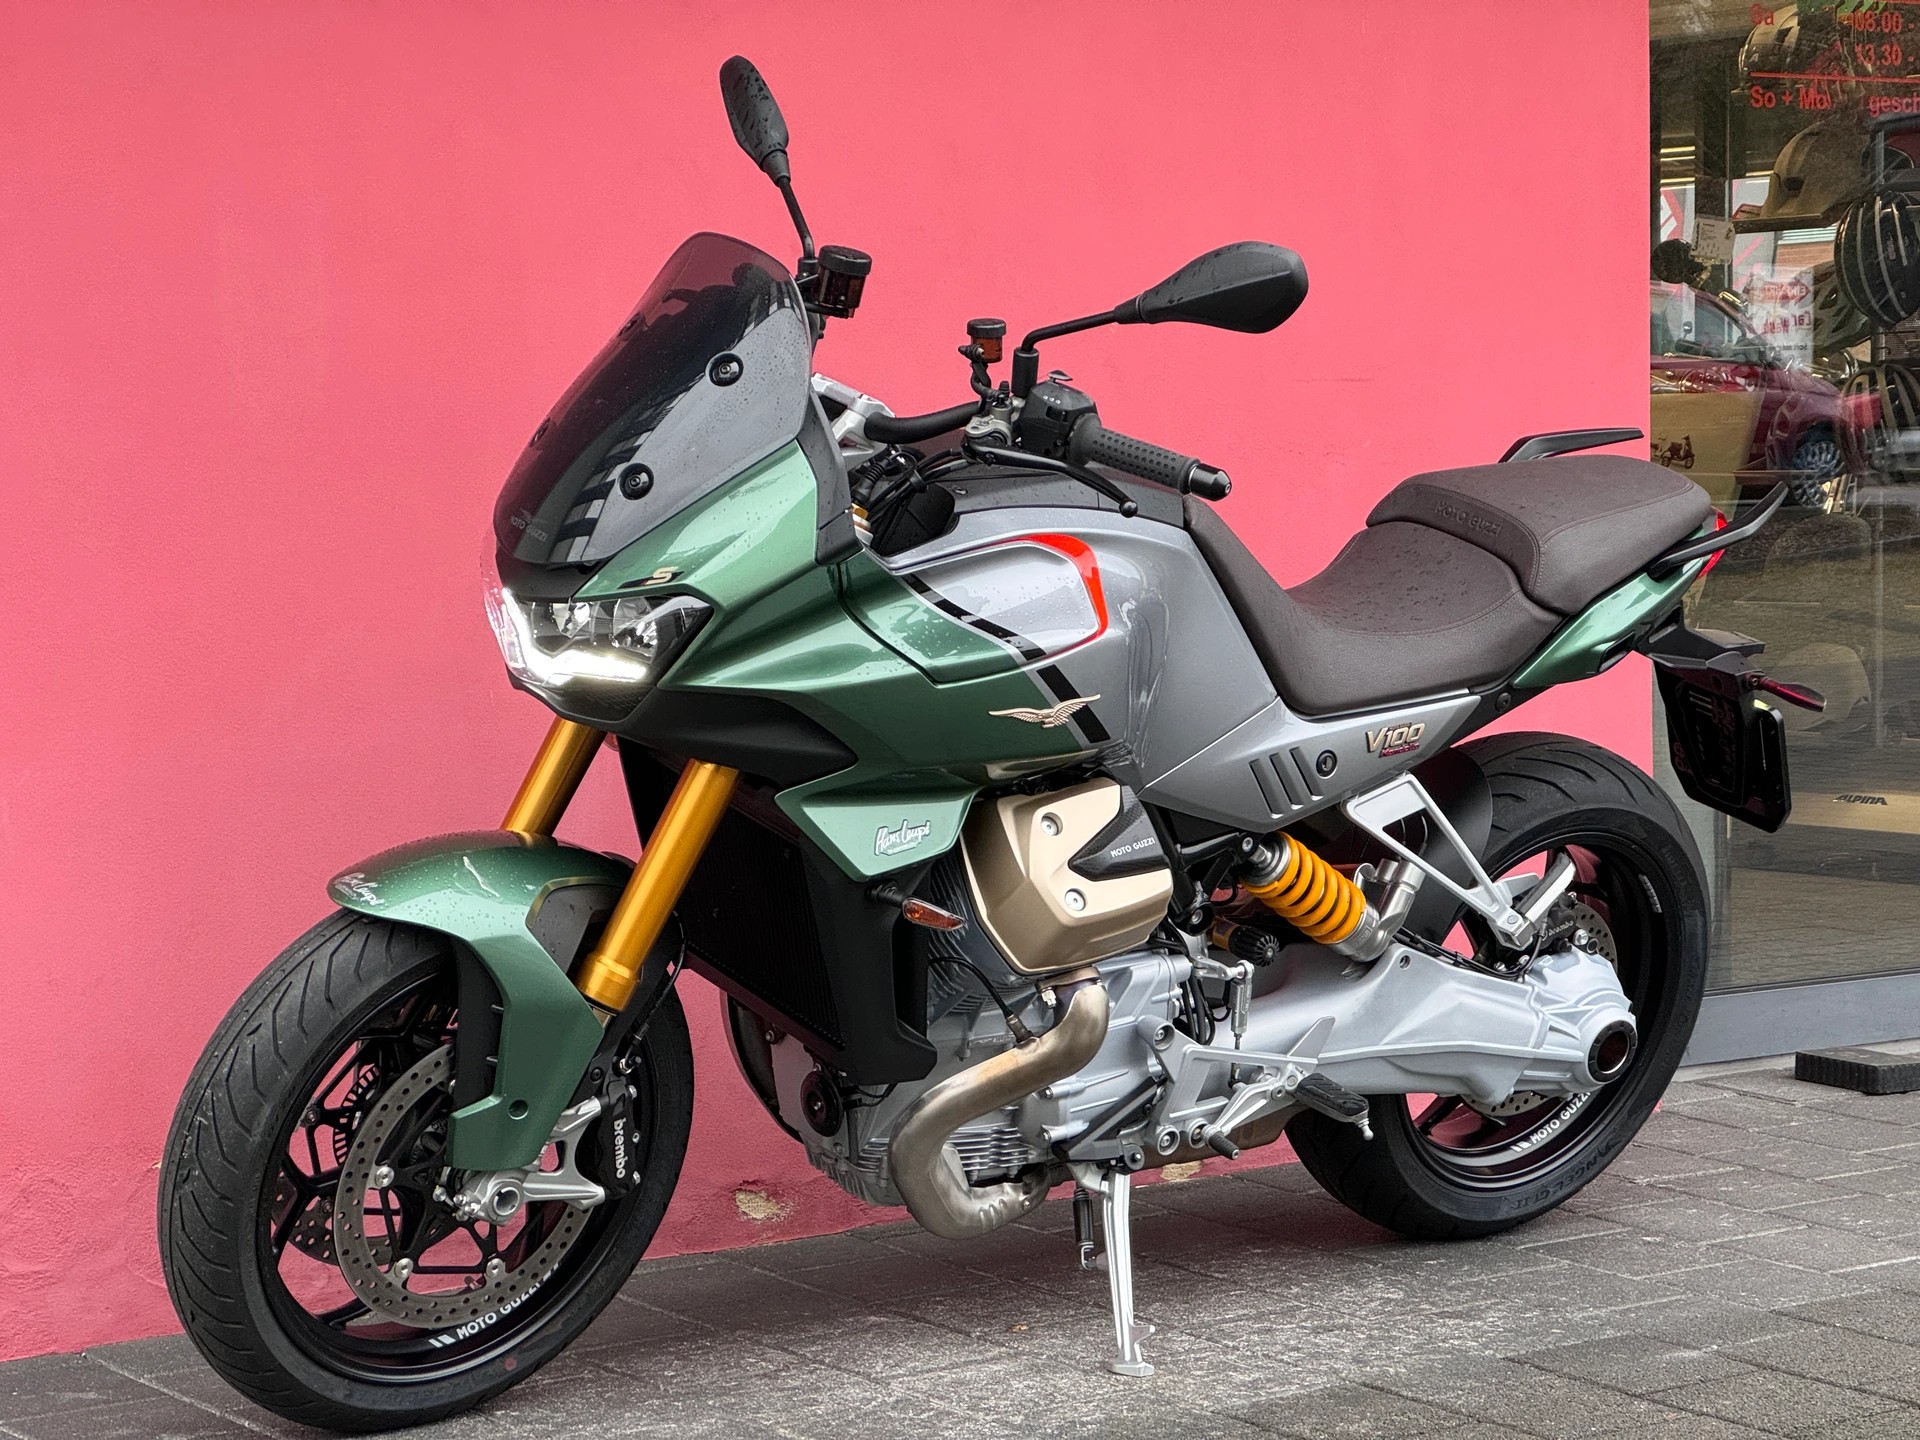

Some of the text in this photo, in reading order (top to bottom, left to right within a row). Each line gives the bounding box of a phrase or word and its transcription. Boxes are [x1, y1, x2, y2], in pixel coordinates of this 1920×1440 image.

[1854, 9, 1902, 33] 08.00
[1855, 43, 1902, 66] 13.30
[1751, 85, 1776, 109] So
[1782, 90, 1793, 106] +
[644, 565, 679, 585] S
[1366, 722, 1426, 753] V100
[1834, 794, 1888, 806] ALPINA
[1110, 837, 1156, 858] MOTO GUZZI
[1530, 1119, 1560, 1144] MOTO
[613, 1117, 629, 1179] brembo
[456, 1312, 497, 1340] MOTO
